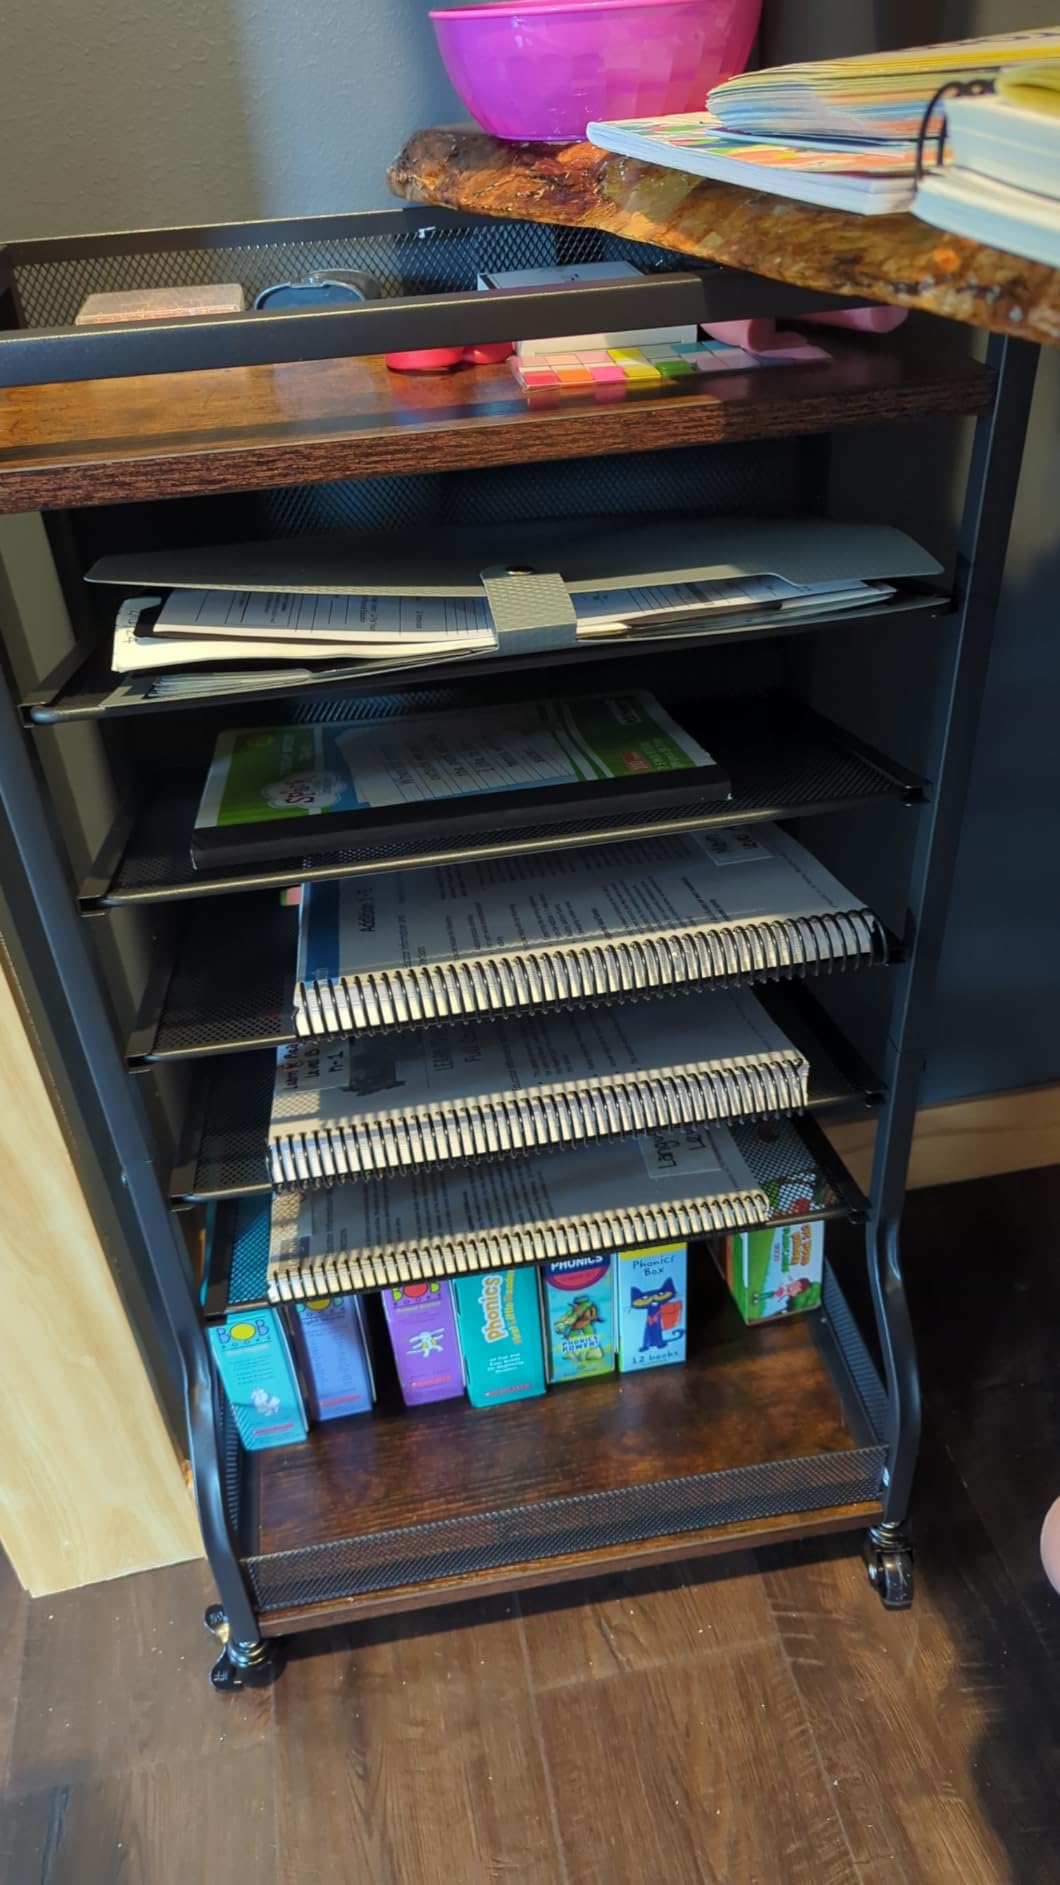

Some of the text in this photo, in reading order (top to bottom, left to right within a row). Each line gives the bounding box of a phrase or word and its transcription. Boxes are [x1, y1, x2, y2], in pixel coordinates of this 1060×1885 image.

[632, 1255, 675, 1269] Phonics
[643, 1267, 665, 1277] Box
[216, 1319, 270, 1344] BOB
[632, 1350, 679, 1364] 12 books
